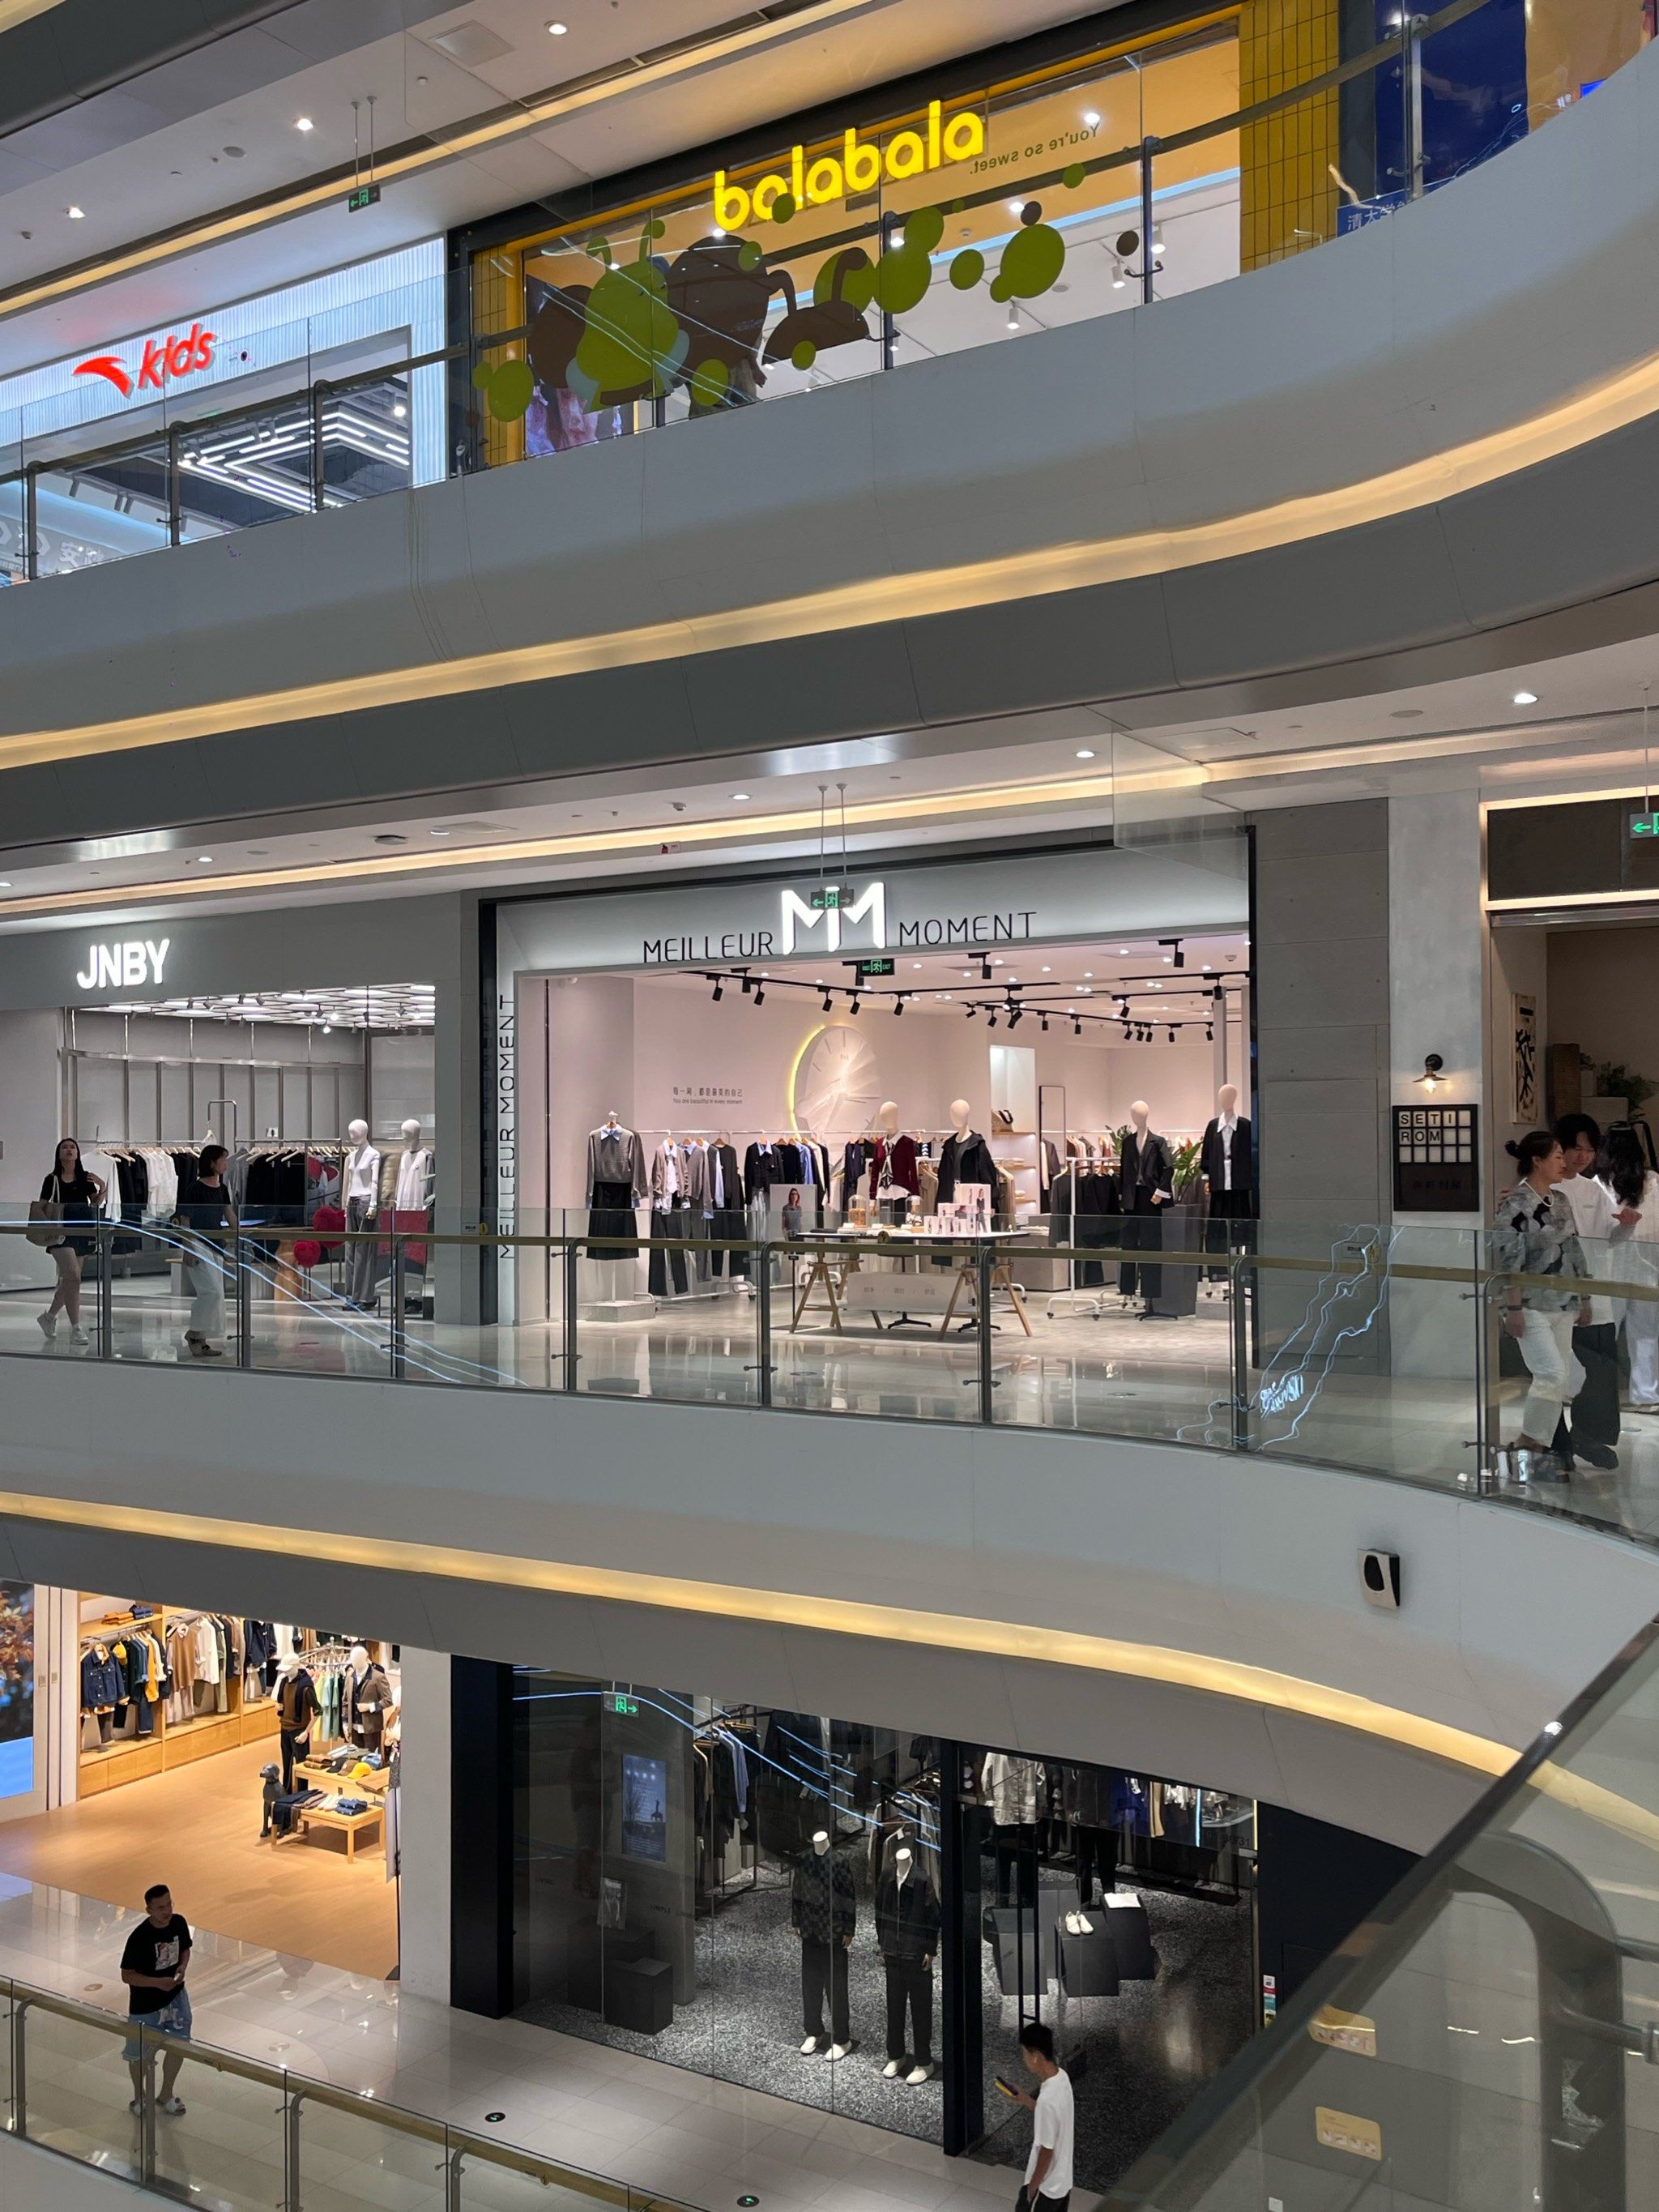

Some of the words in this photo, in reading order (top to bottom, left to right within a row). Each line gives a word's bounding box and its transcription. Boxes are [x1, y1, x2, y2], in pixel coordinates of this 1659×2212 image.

[714, 100, 983, 231] balabala
[138, 322, 215, 390] kids
[77, 938, 170, 989] JNBY
[643, 931, 774, 963] MEILLEUR
[898, 912, 1037, 947] MOMENT
[499, 994, 515, 1115] MOMENT
[1400, 1113, 1452, 1125] SETI
[1400, 1130, 1440, 1142] ROM
[499, 1127, 515, 1259] MEILLEUR
